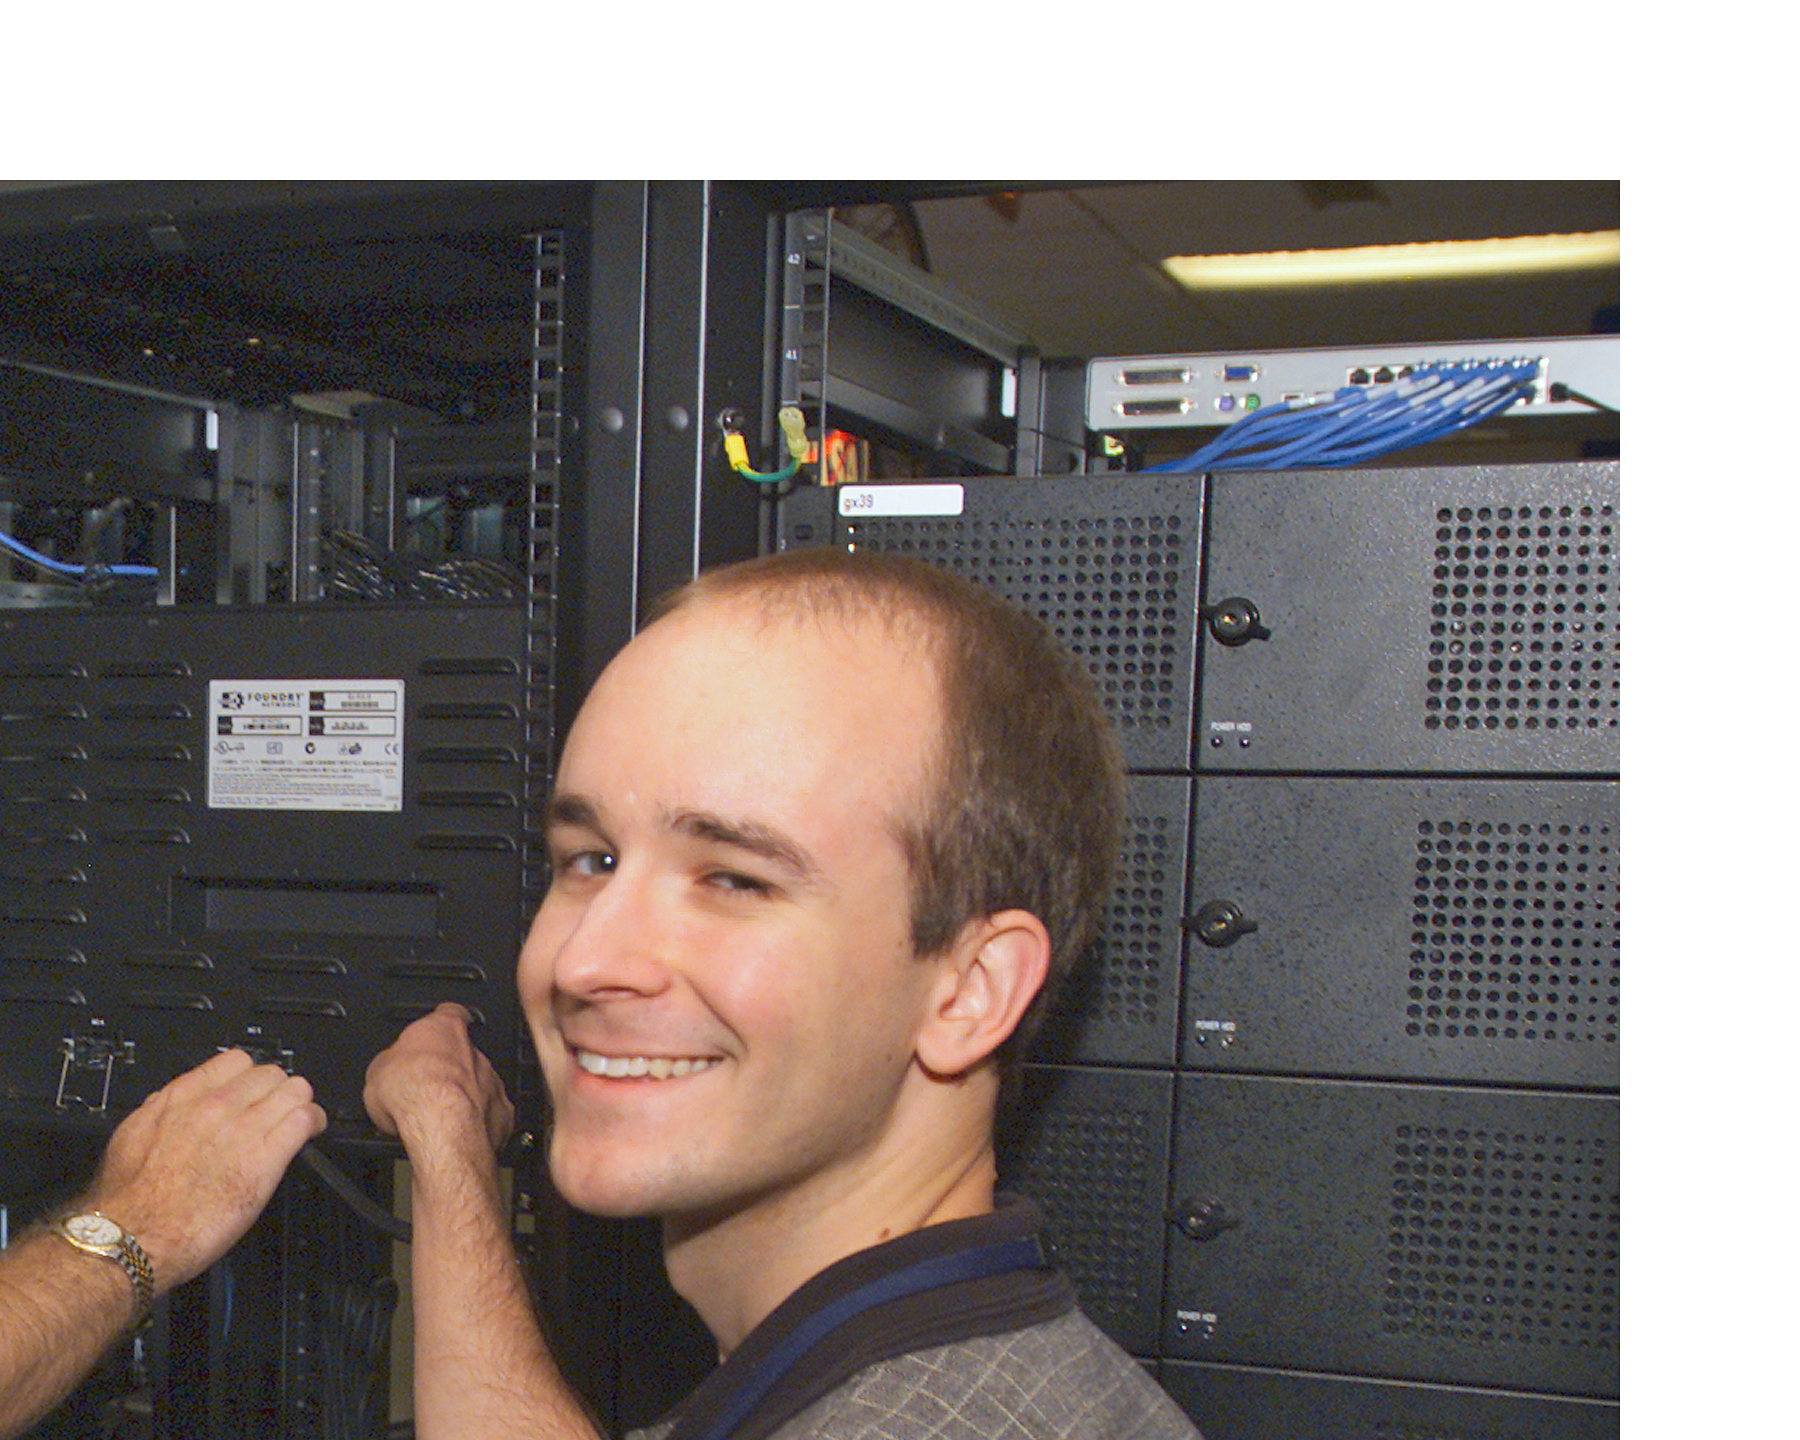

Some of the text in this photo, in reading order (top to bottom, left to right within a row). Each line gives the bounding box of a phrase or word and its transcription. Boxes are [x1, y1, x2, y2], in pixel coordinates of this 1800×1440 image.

[788, 252, 801, 265] 42
[785, 349, 798, 361] 41
[247, 691, 301, 702] FOUNDRY
